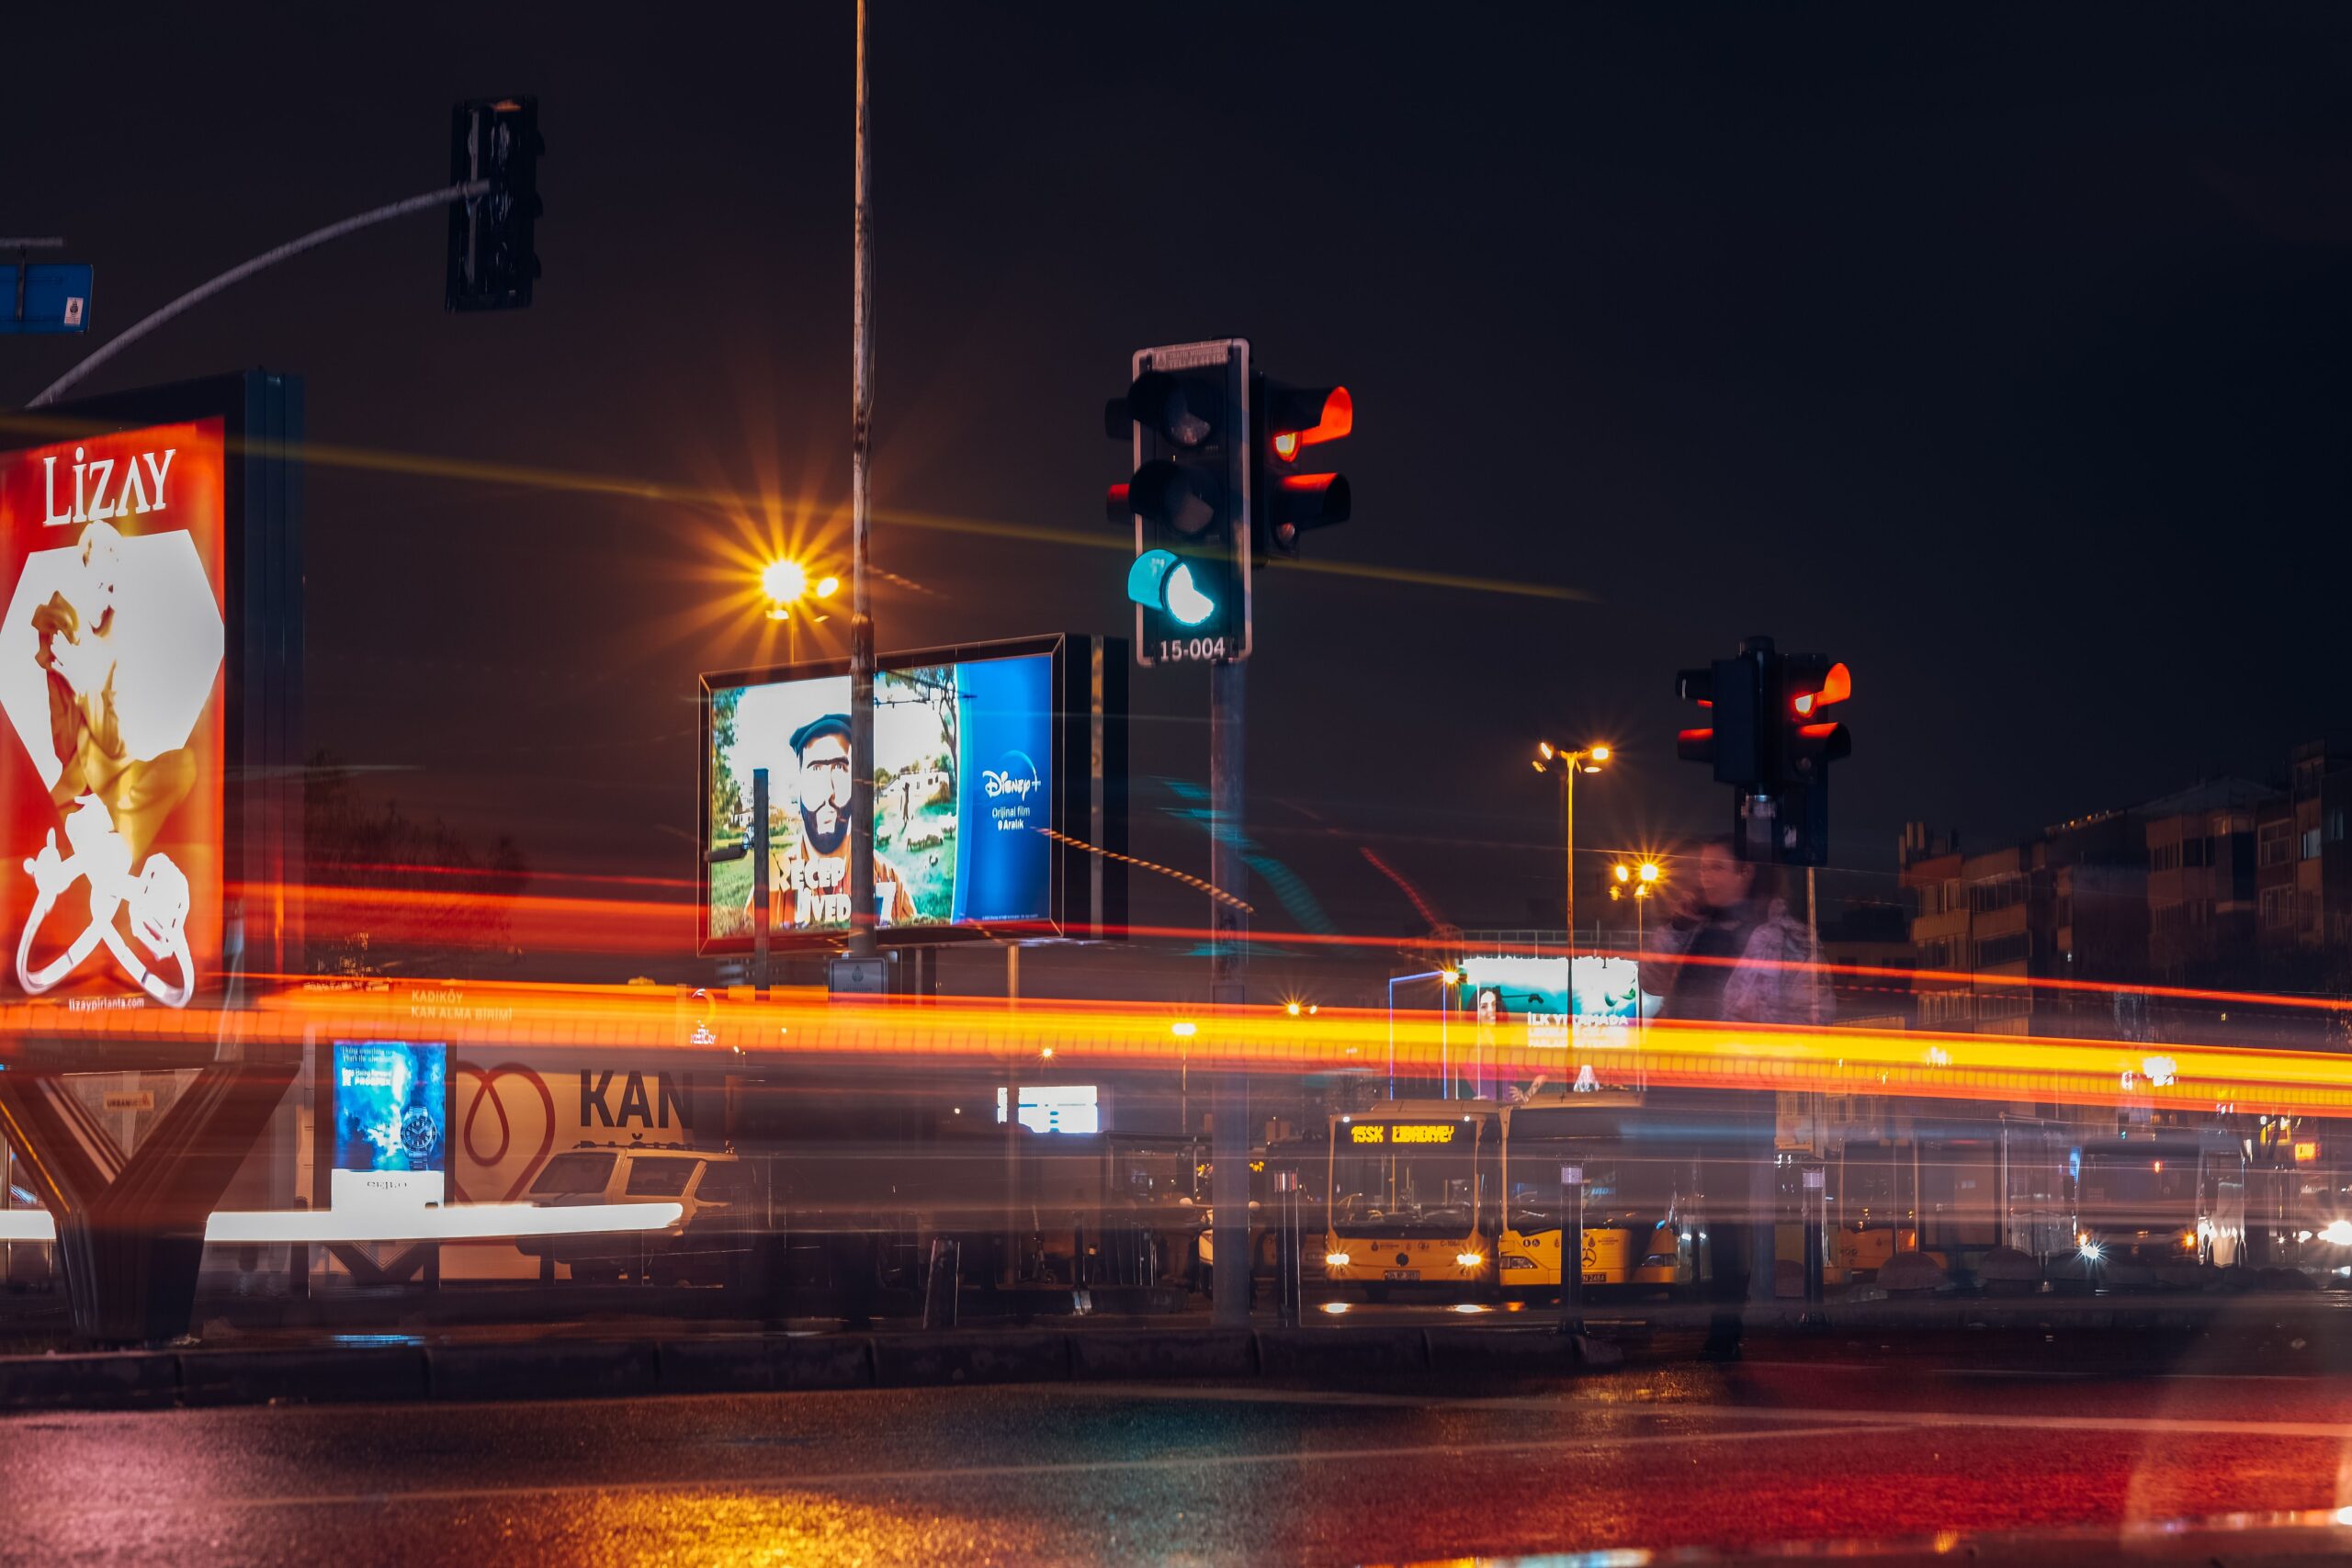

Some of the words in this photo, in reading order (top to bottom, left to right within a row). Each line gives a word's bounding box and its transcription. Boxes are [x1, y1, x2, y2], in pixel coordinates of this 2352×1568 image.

[1160, 637, 1225, 662] 15-004
[982, 770, 1041, 802] Disney+
[1017, 806, 1030, 817] film
[774, 854, 845, 893] RECEP
[875, 880, 897, 927] 7
[68, 997, 144, 1012] lizaypirlanta.com
[412, 988, 463, 1004] KADIKÖY
[412, 1006, 436, 1019] KAN
[439, 1006, 471, 1020] ALMA
[580, 1068, 694, 1130] KAN
